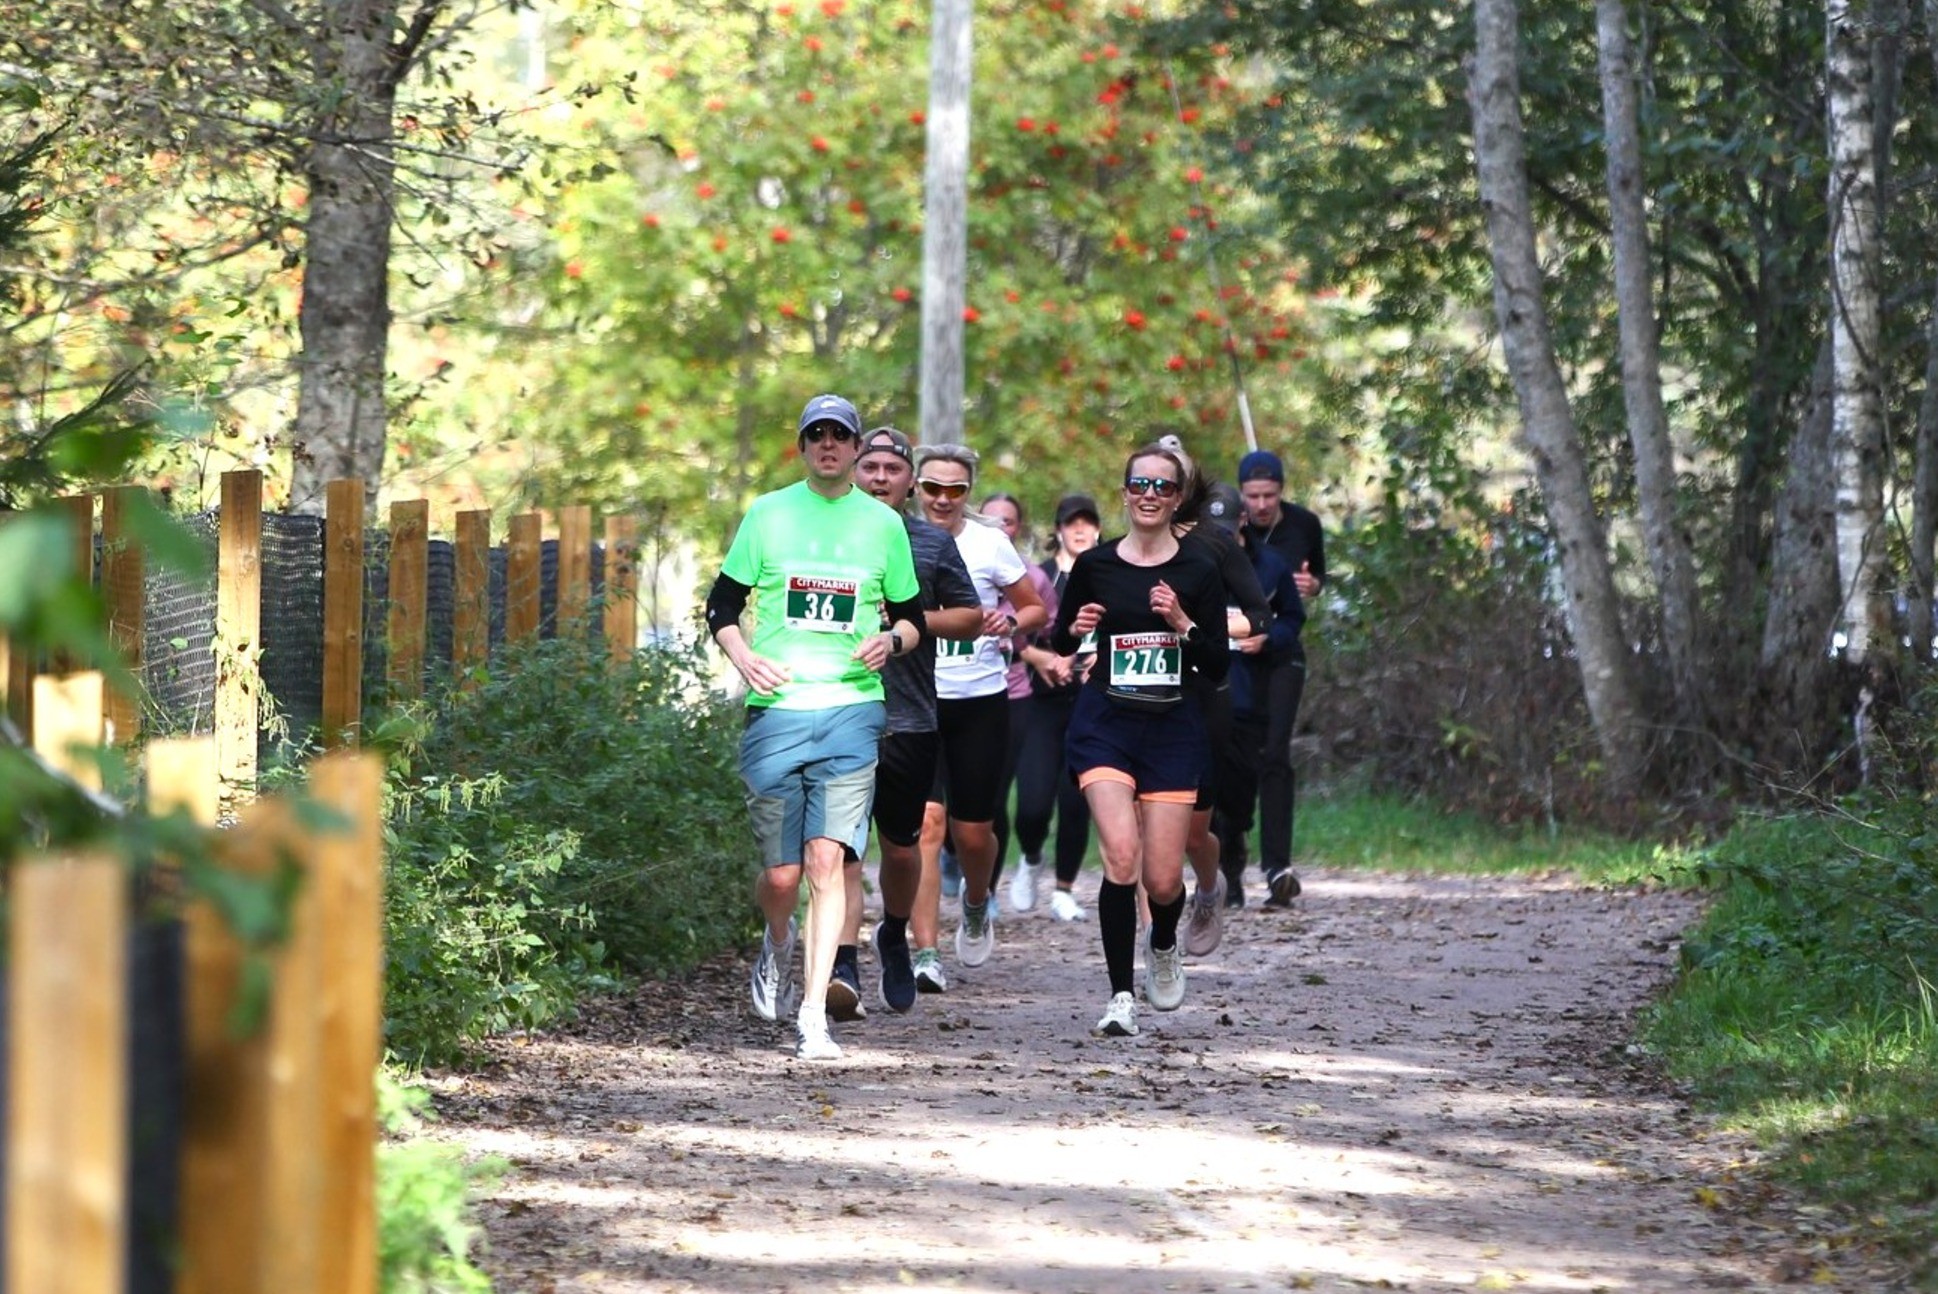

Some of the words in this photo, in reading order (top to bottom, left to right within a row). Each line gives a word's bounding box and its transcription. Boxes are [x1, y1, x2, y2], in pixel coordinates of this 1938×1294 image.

[797, 578, 855, 590] CITYMARKET
[805, 593, 835, 621] 36
[1125, 649, 1167, 676] 276
